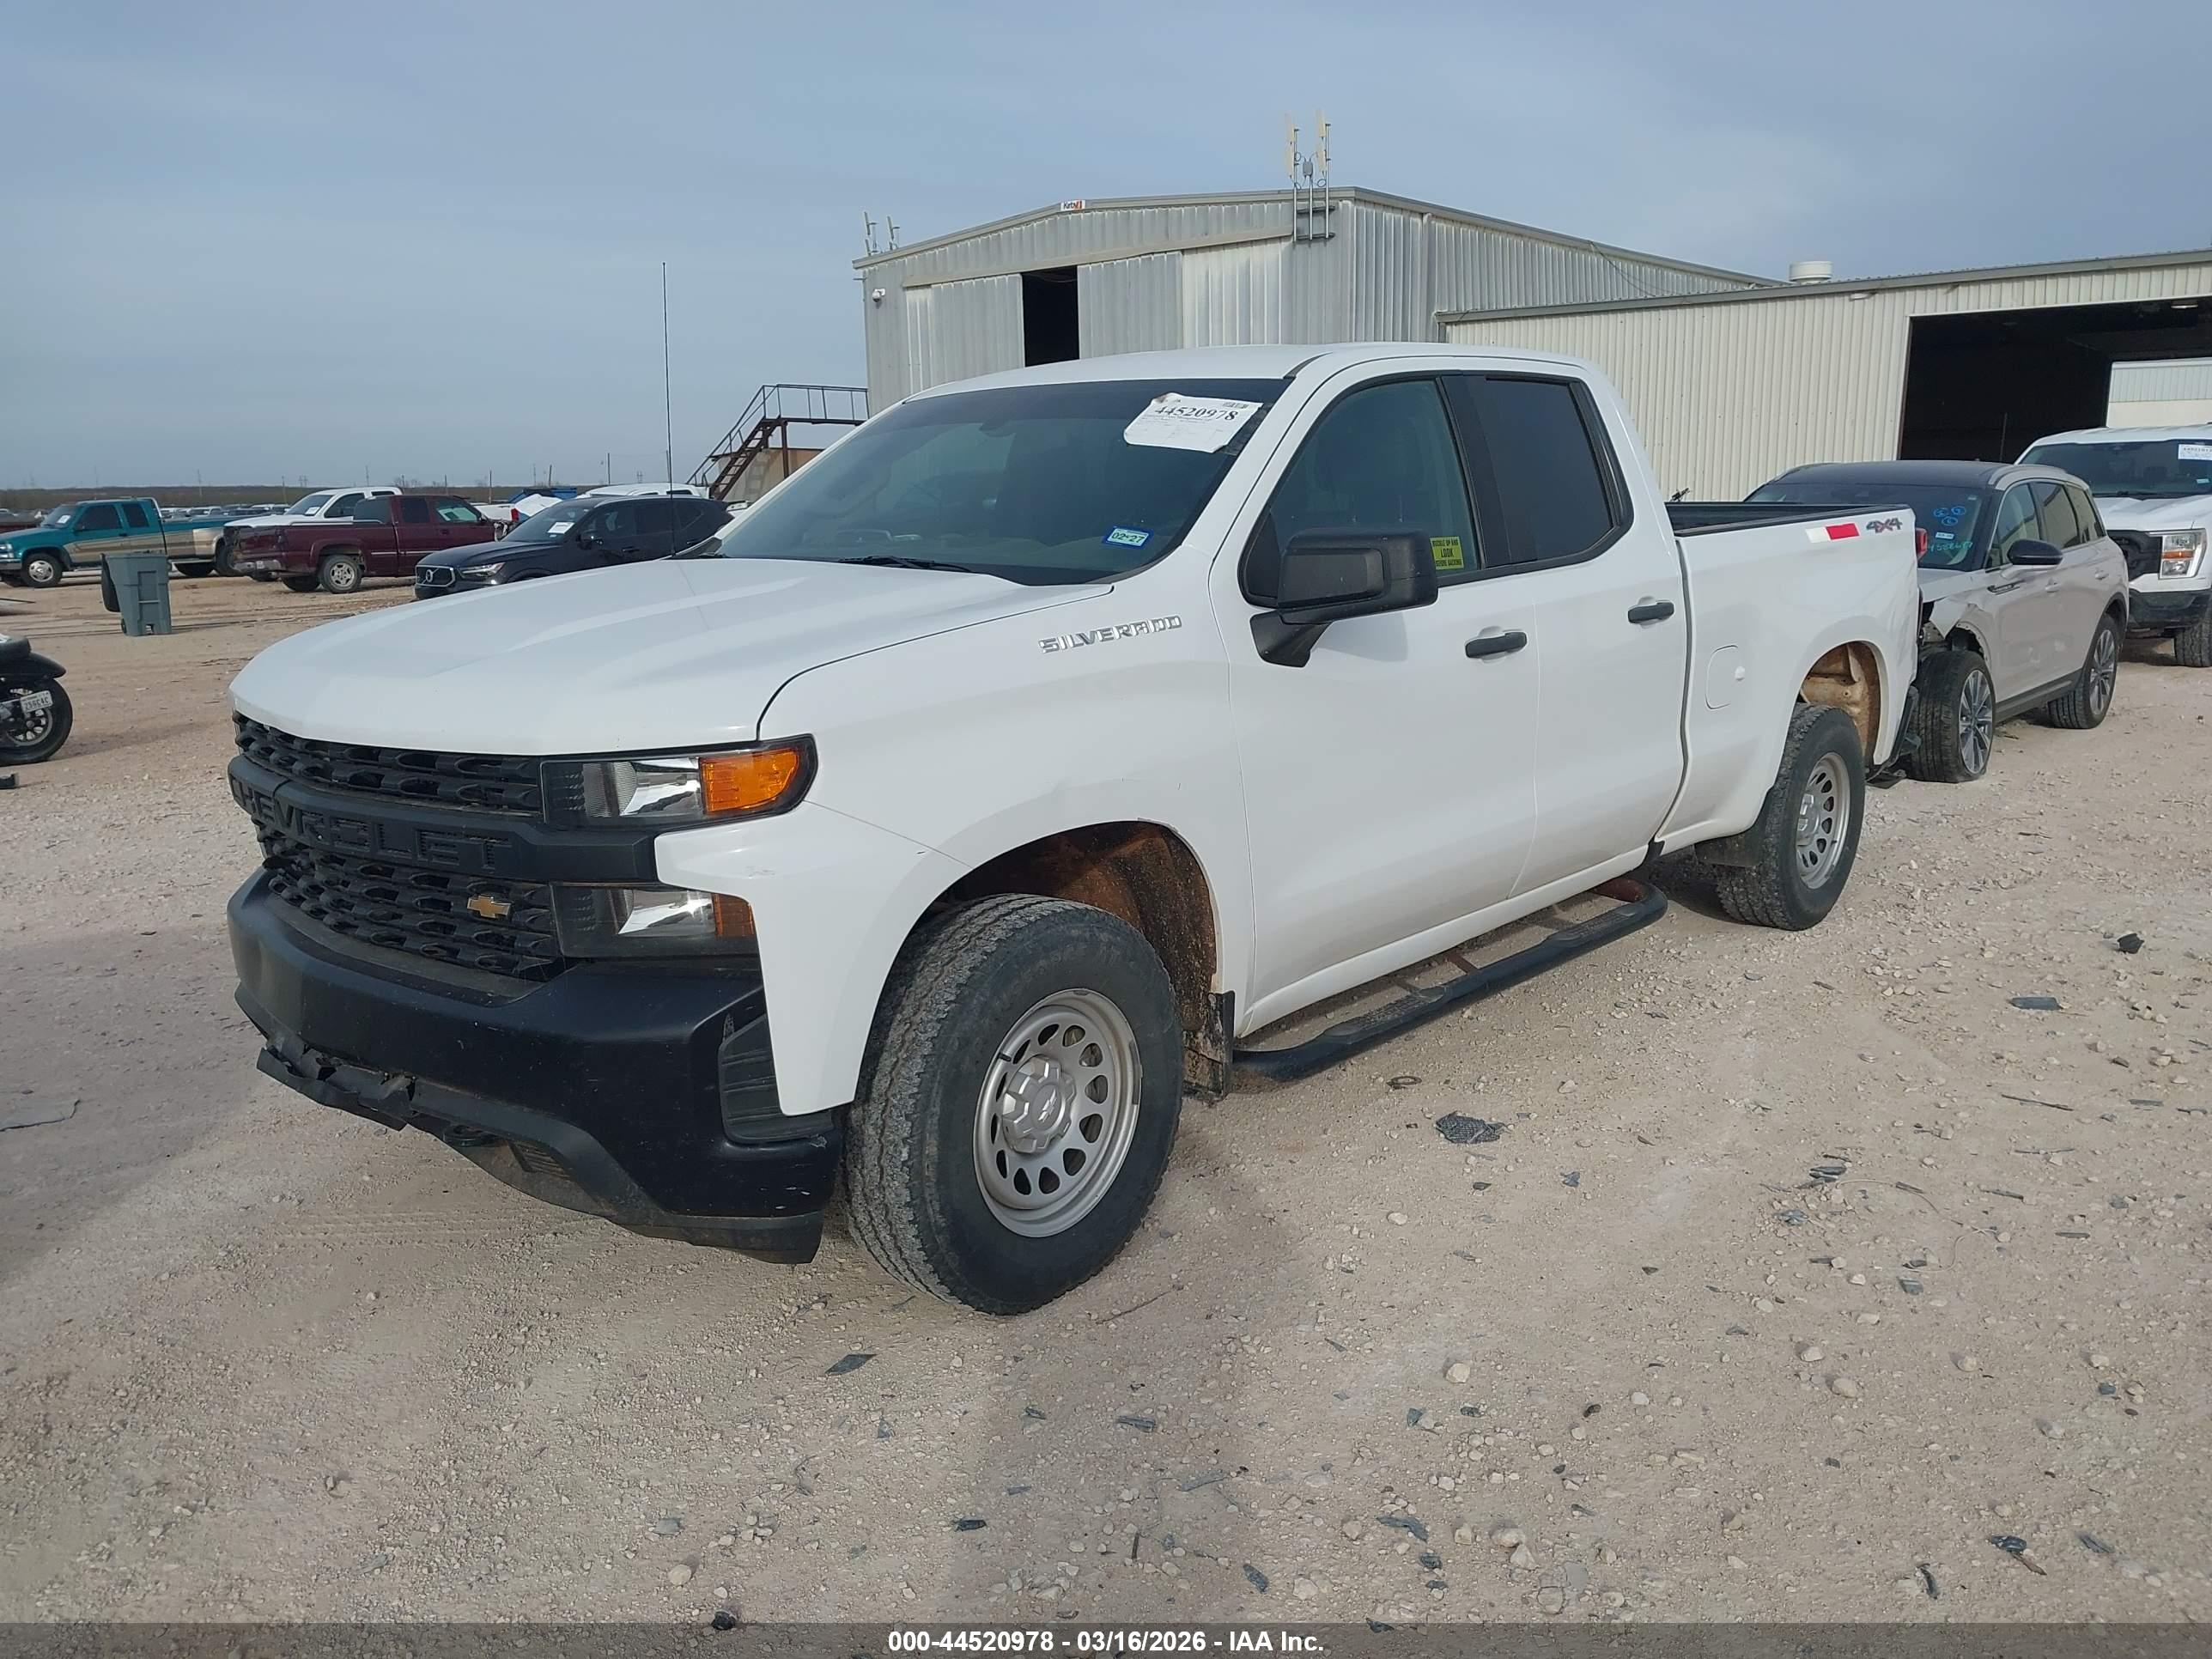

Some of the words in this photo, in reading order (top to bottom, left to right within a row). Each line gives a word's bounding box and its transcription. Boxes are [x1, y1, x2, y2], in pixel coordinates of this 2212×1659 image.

[1155, 405, 1238, 421] 44520978
[1441, 548, 1455, 558] LOOK
[1038, 615, 1182, 653] SILVERADO
[228, 775, 513, 871] CHEVROLET
